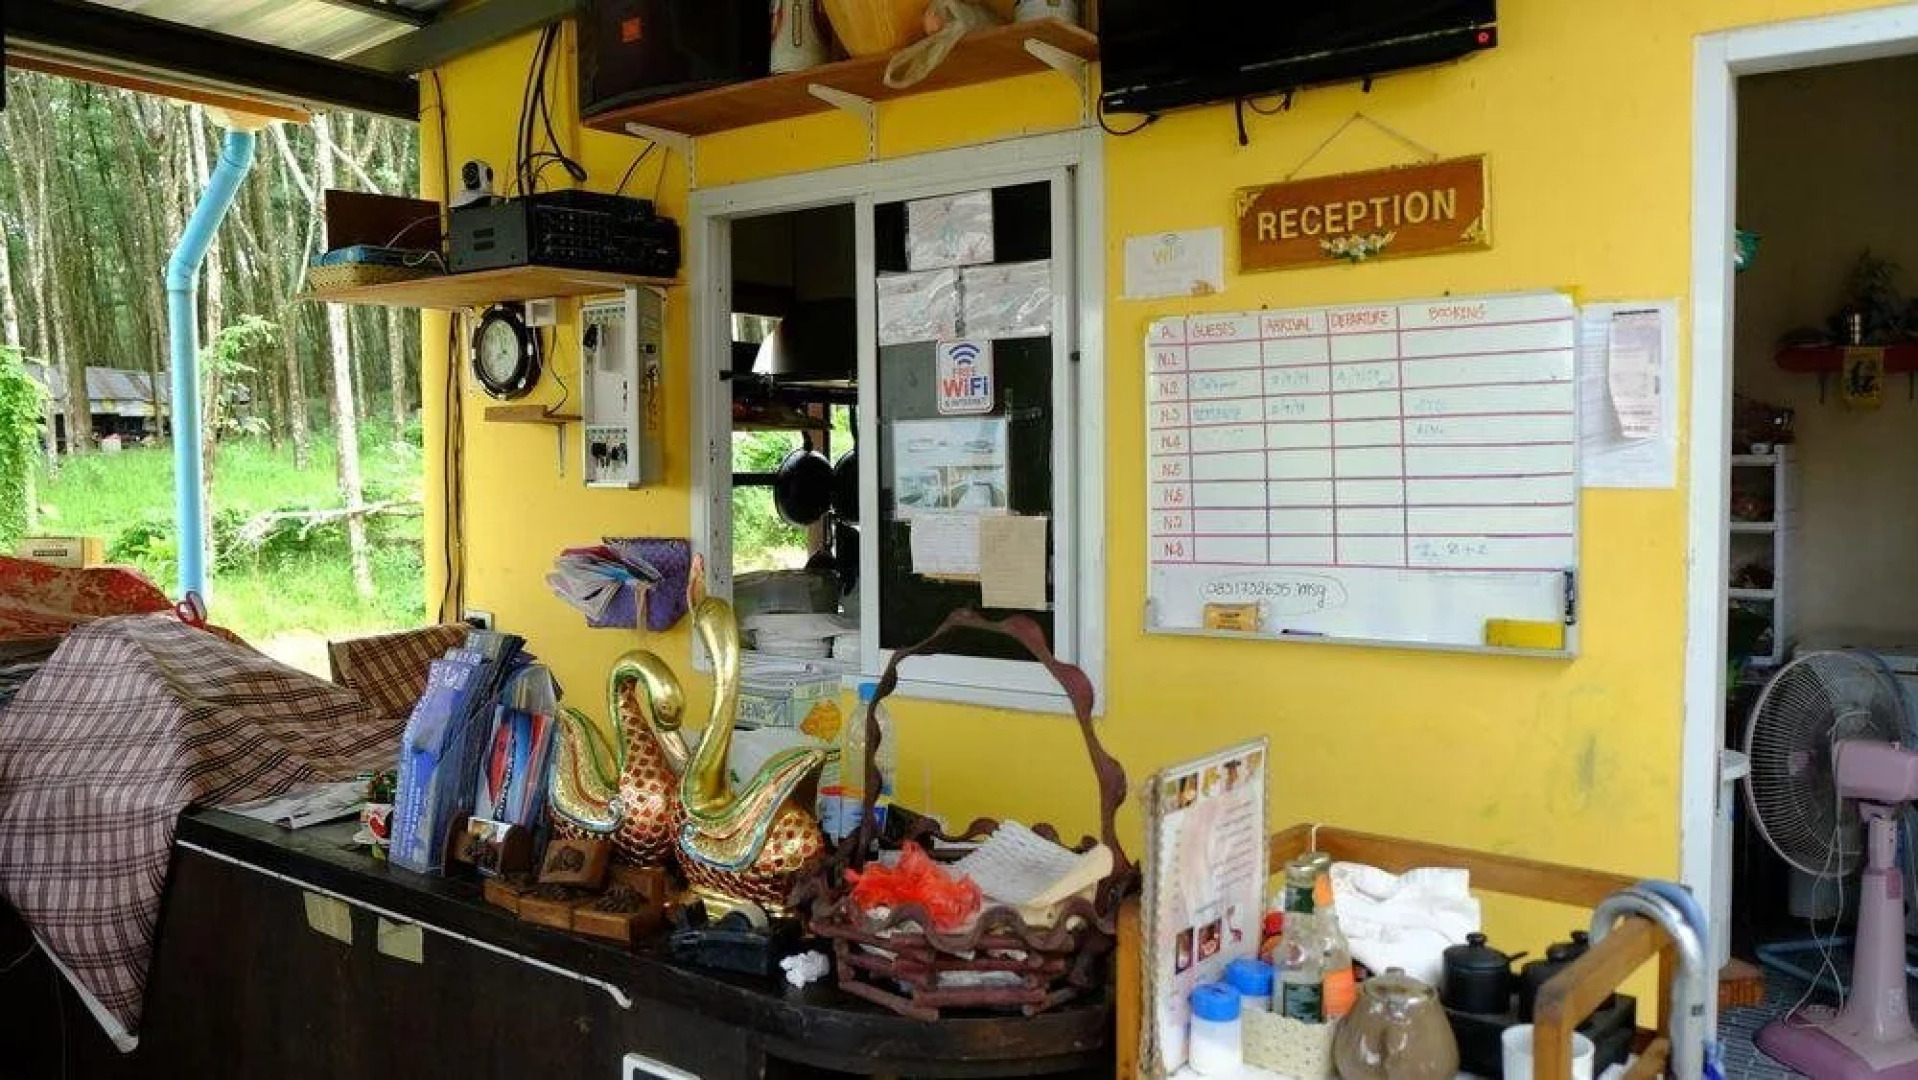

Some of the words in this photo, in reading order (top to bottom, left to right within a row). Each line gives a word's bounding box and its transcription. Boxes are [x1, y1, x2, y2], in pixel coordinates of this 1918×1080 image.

[1257, 187, 1456, 241] RECEPTION
[1266, 317, 1310, 333] ARRIVAL
[1330, 311, 1390, 329] DEPARTURE
[1428, 303, 1488, 321] BOOKING
